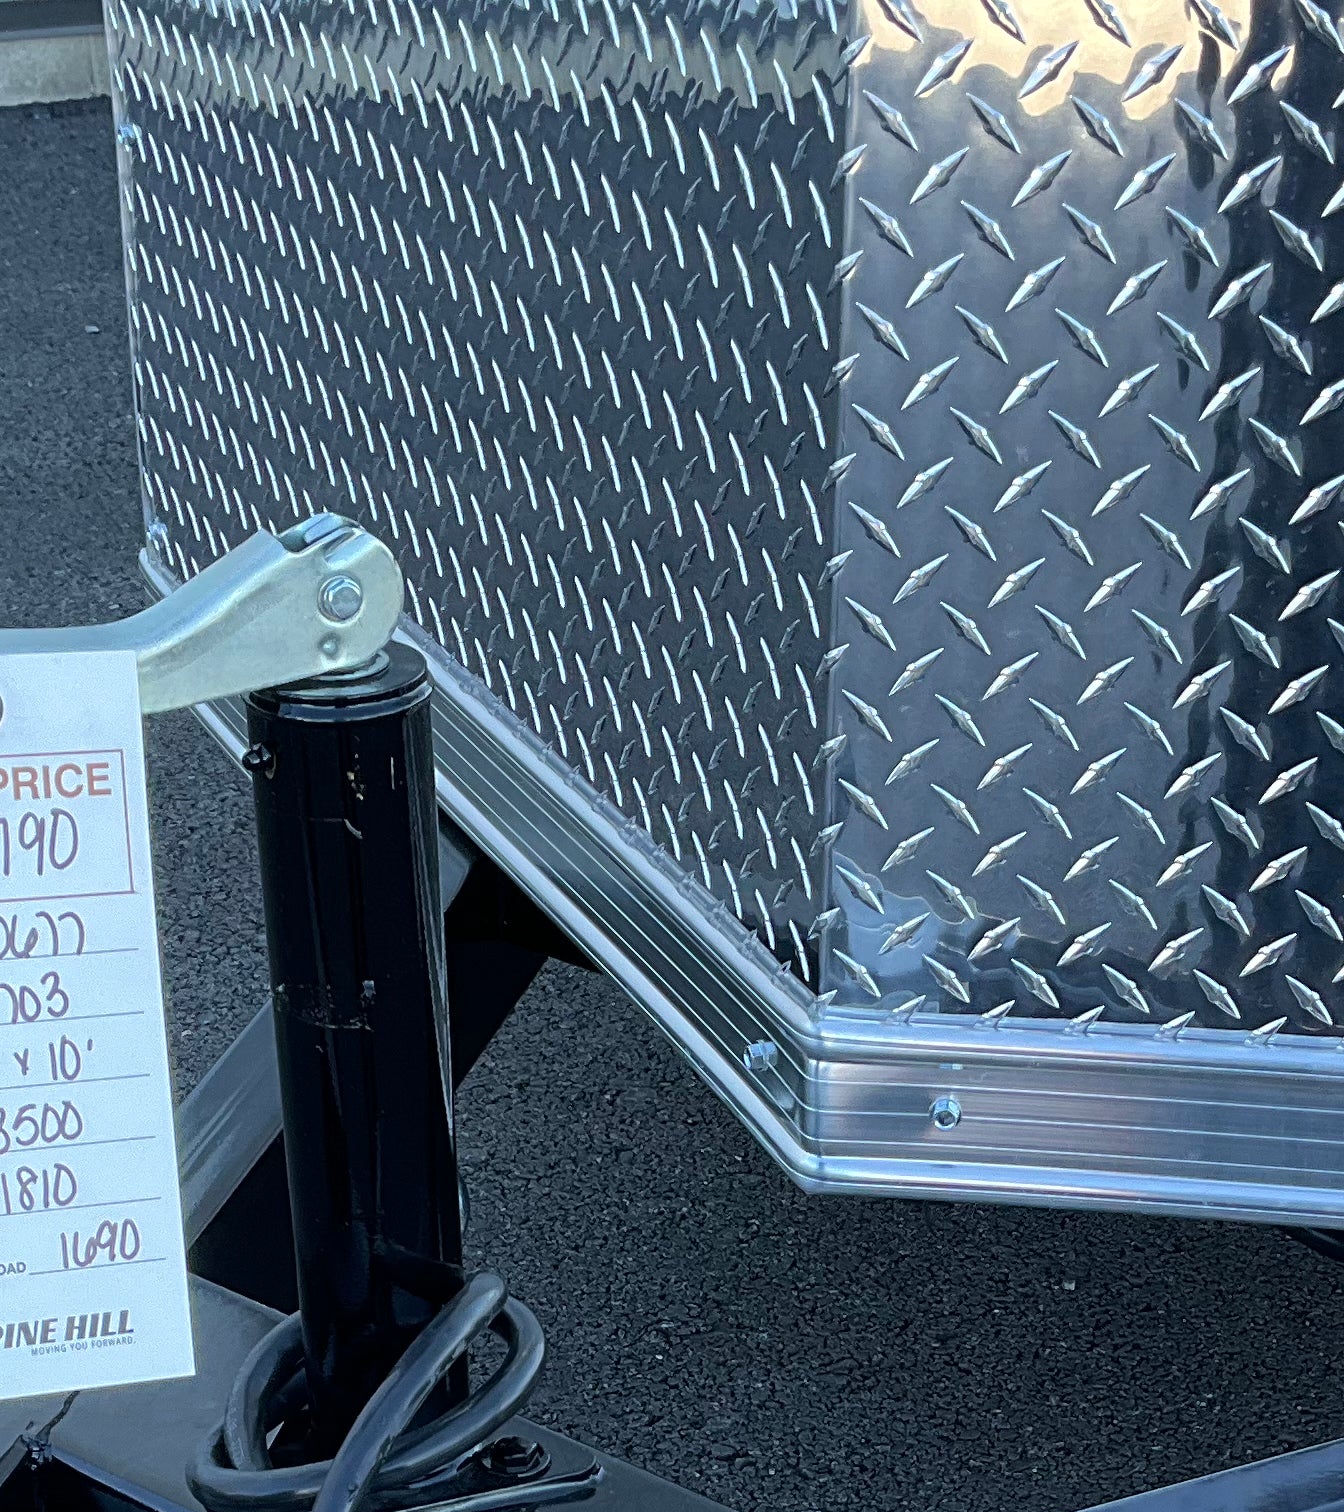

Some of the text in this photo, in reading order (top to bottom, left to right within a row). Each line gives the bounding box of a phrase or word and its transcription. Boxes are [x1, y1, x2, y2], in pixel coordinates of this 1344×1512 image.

[48, 1034, 94, 1083] 10'
[0, 1163, 78, 1215] 1810
[59, 1218, 141, 1269] 1690
[30, 1336, 137, 1356] MOVING YOU FORWARD.
[64, 1310, 135, 1338] HILL
